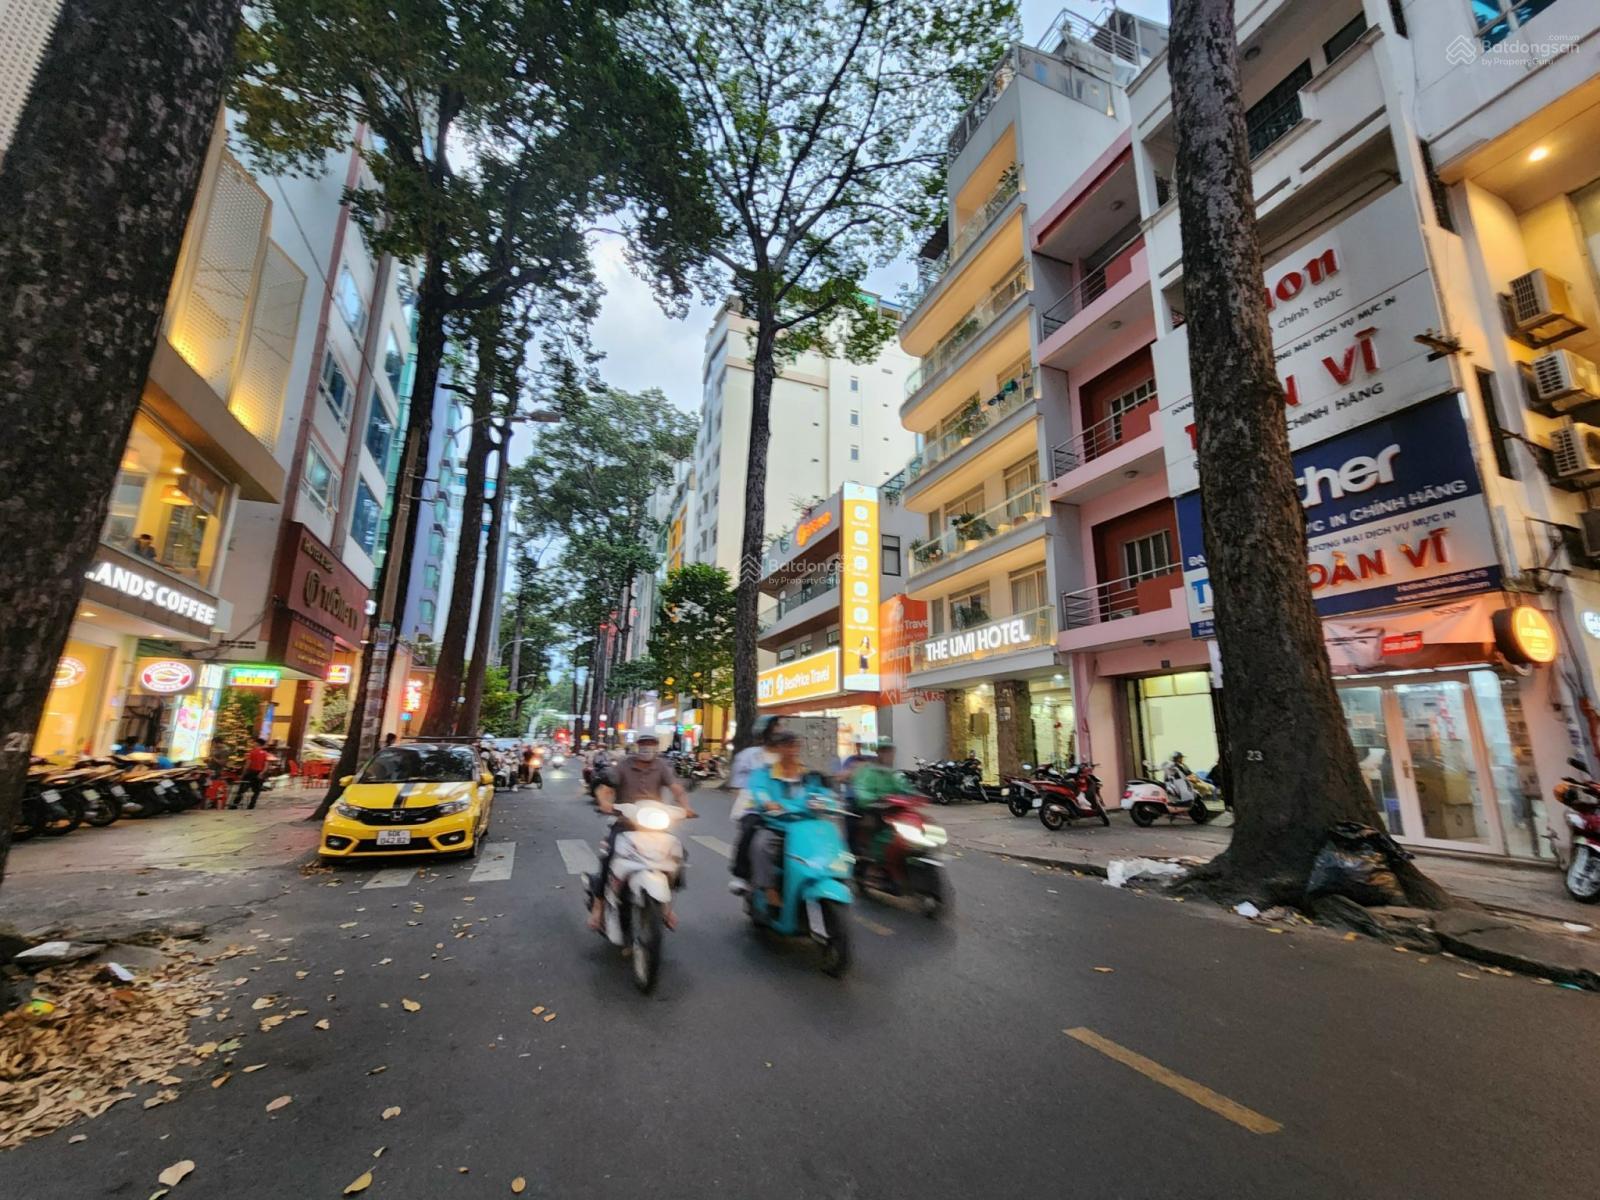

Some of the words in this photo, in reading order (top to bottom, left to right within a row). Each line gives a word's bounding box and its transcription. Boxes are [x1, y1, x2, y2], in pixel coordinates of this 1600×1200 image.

[1329, 513, 1348, 527] IN
[1351, 496, 1407, 522] CHÍNH
[1442, 510, 1456, 519] IN
[155, 586, 217, 626] COFFEE
[924, 638, 948, 662] THE
[950, 632, 976, 657] UMI
[977, 618, 1032, 651] HOTEL
